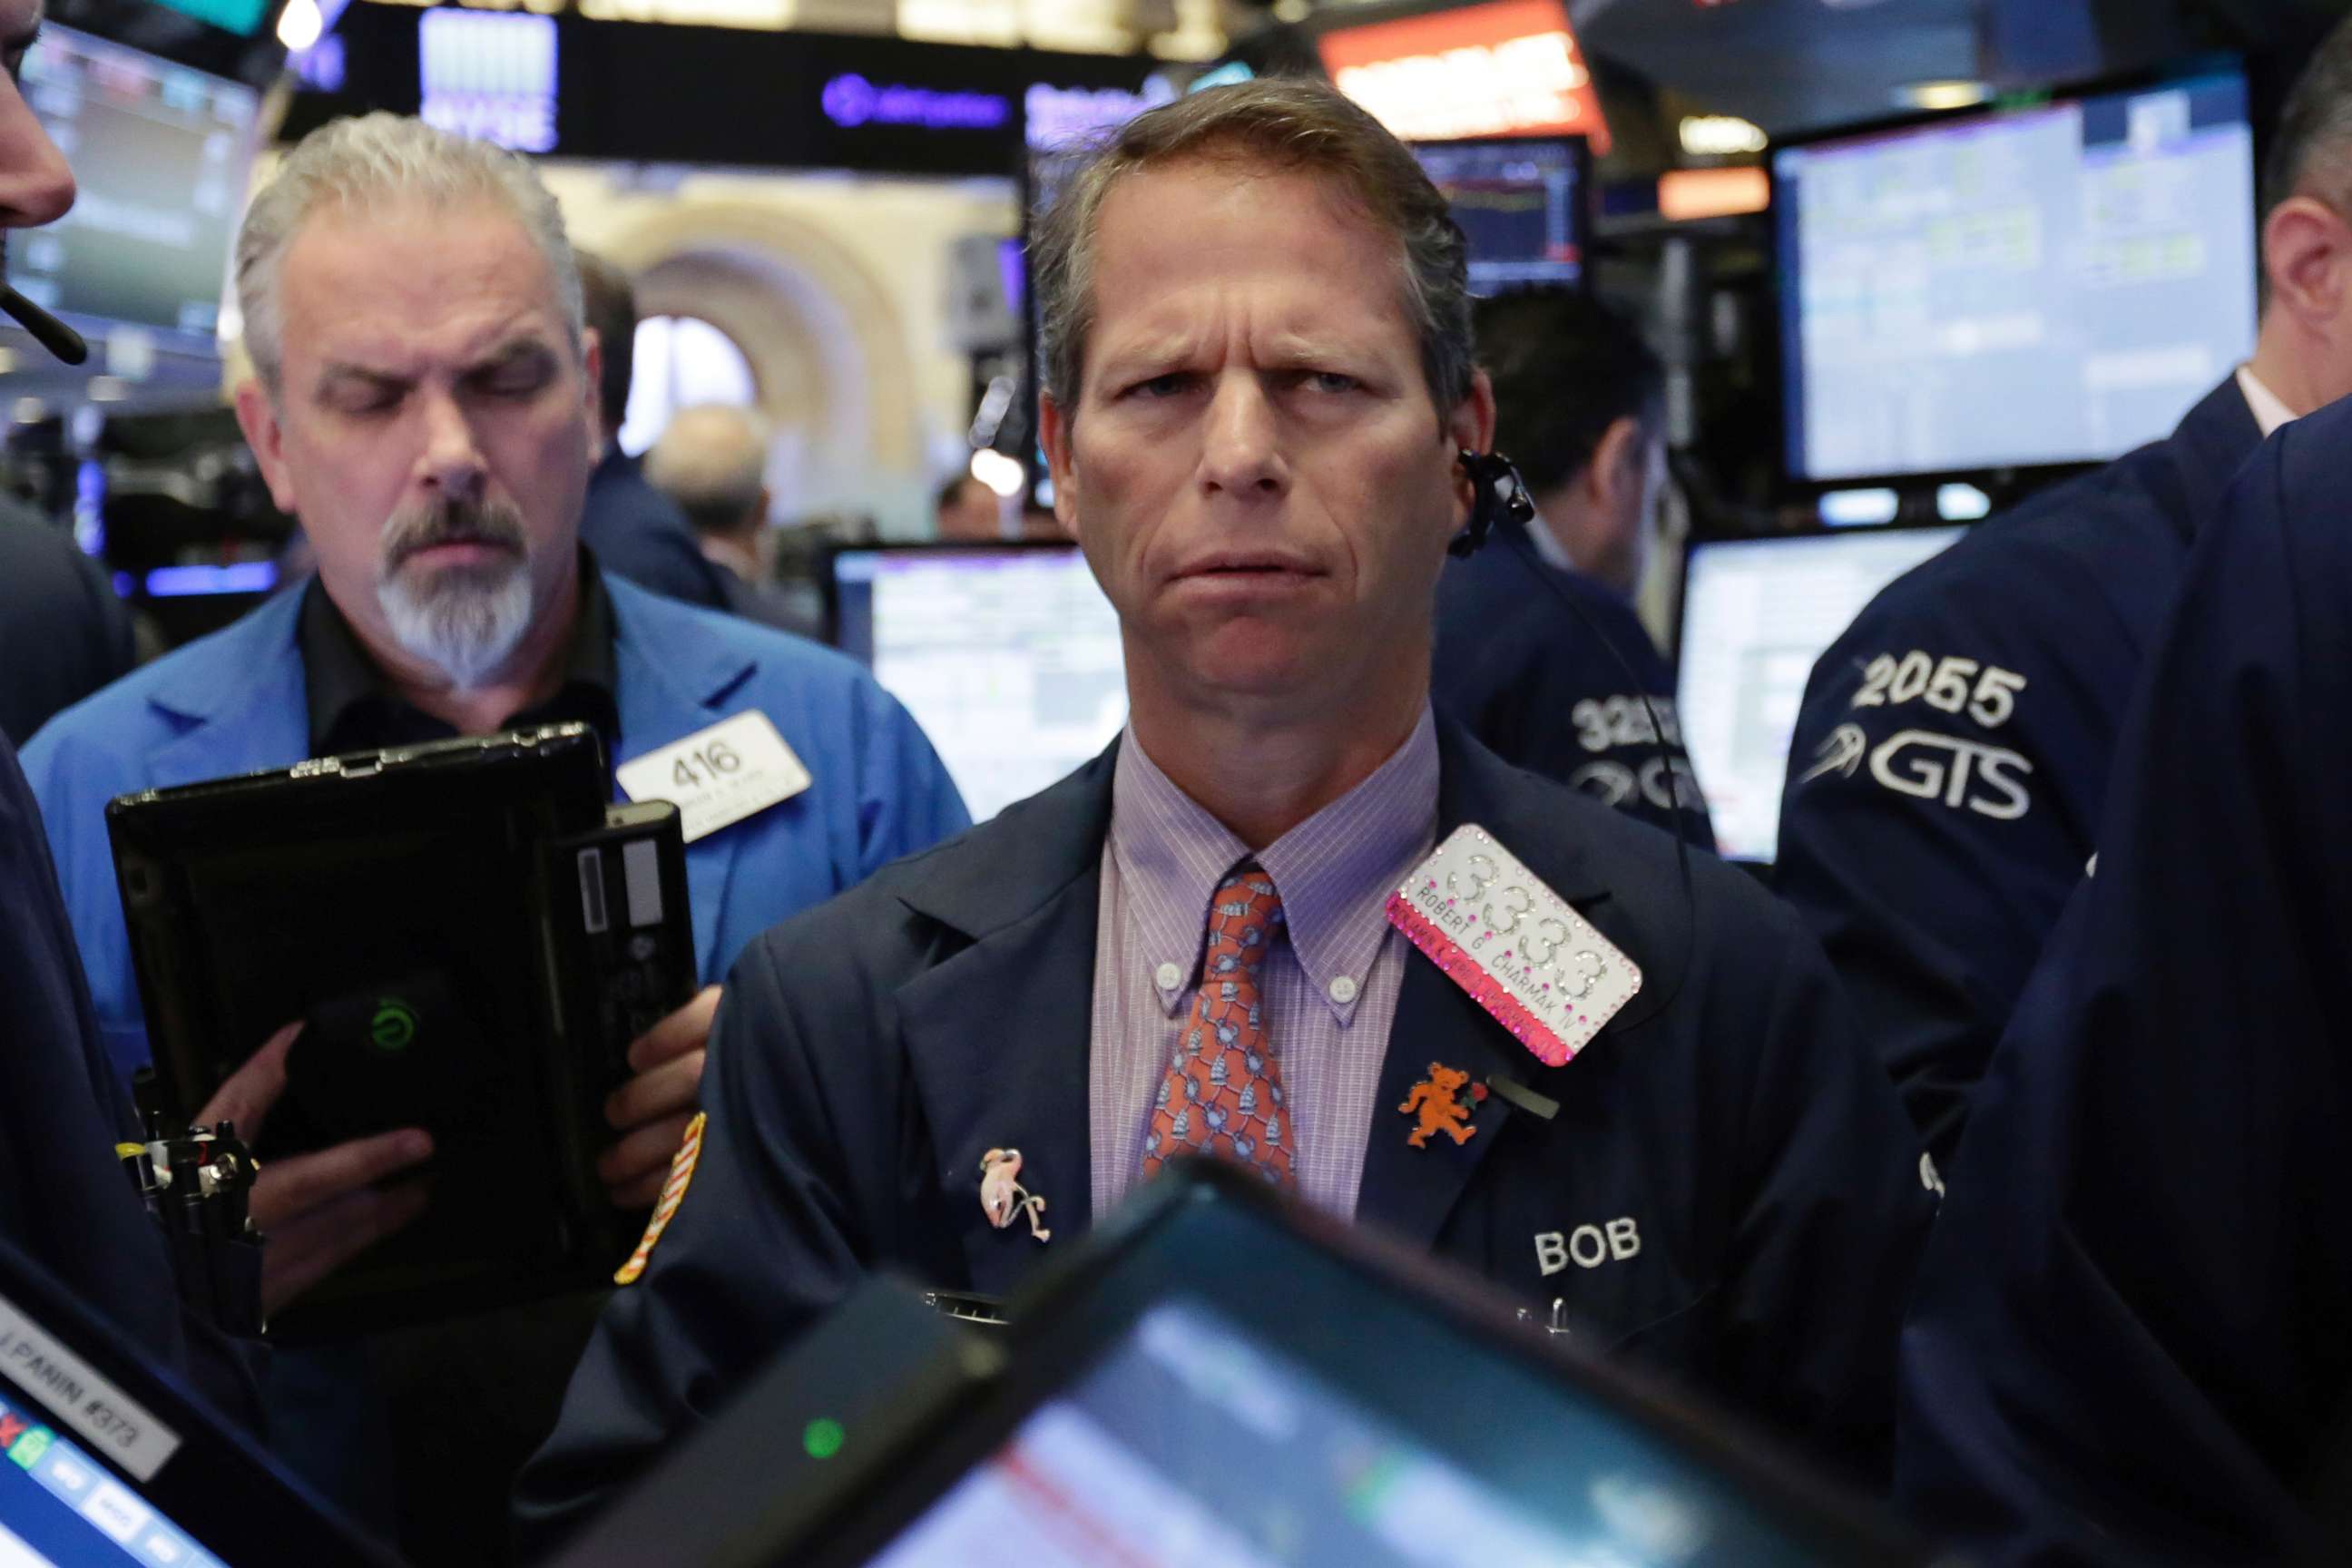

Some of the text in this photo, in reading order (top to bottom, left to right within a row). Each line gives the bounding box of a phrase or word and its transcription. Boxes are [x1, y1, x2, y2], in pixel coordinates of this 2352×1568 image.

[1849, 649, 2028, 729] 2055
[671, 738, 741, 788] 416
[1869, 729, 2034, 821] GTS
[1416, 886, 1471, 936] ROBERT
[1471, 936, 1486, 951] G
[1491, 948, 1561, 1014] CHARMAK
[1446, 853, 1610, 1002] 3333
[1534, 1216, 1642, 1277] BOB
